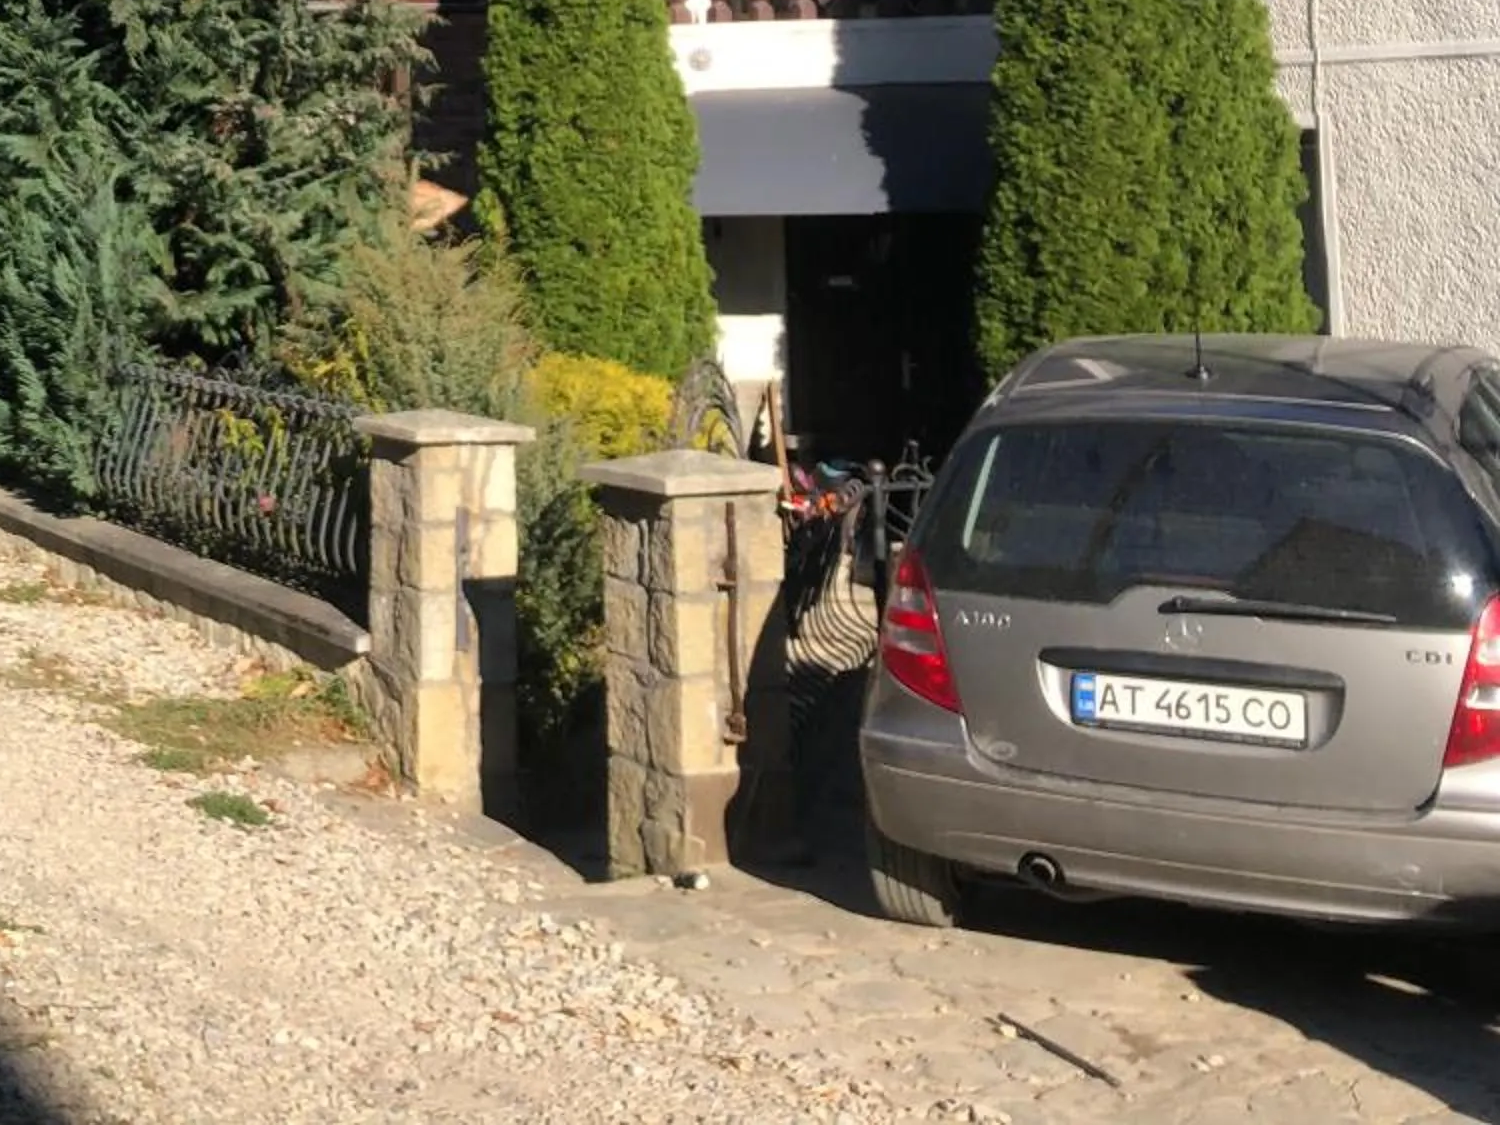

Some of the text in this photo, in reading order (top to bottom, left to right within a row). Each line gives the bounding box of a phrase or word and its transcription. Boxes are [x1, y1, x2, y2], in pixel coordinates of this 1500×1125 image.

[1404, 650, 1453, 665] CDI
[1099, 683, 1292, 731] AT 4615 CO
